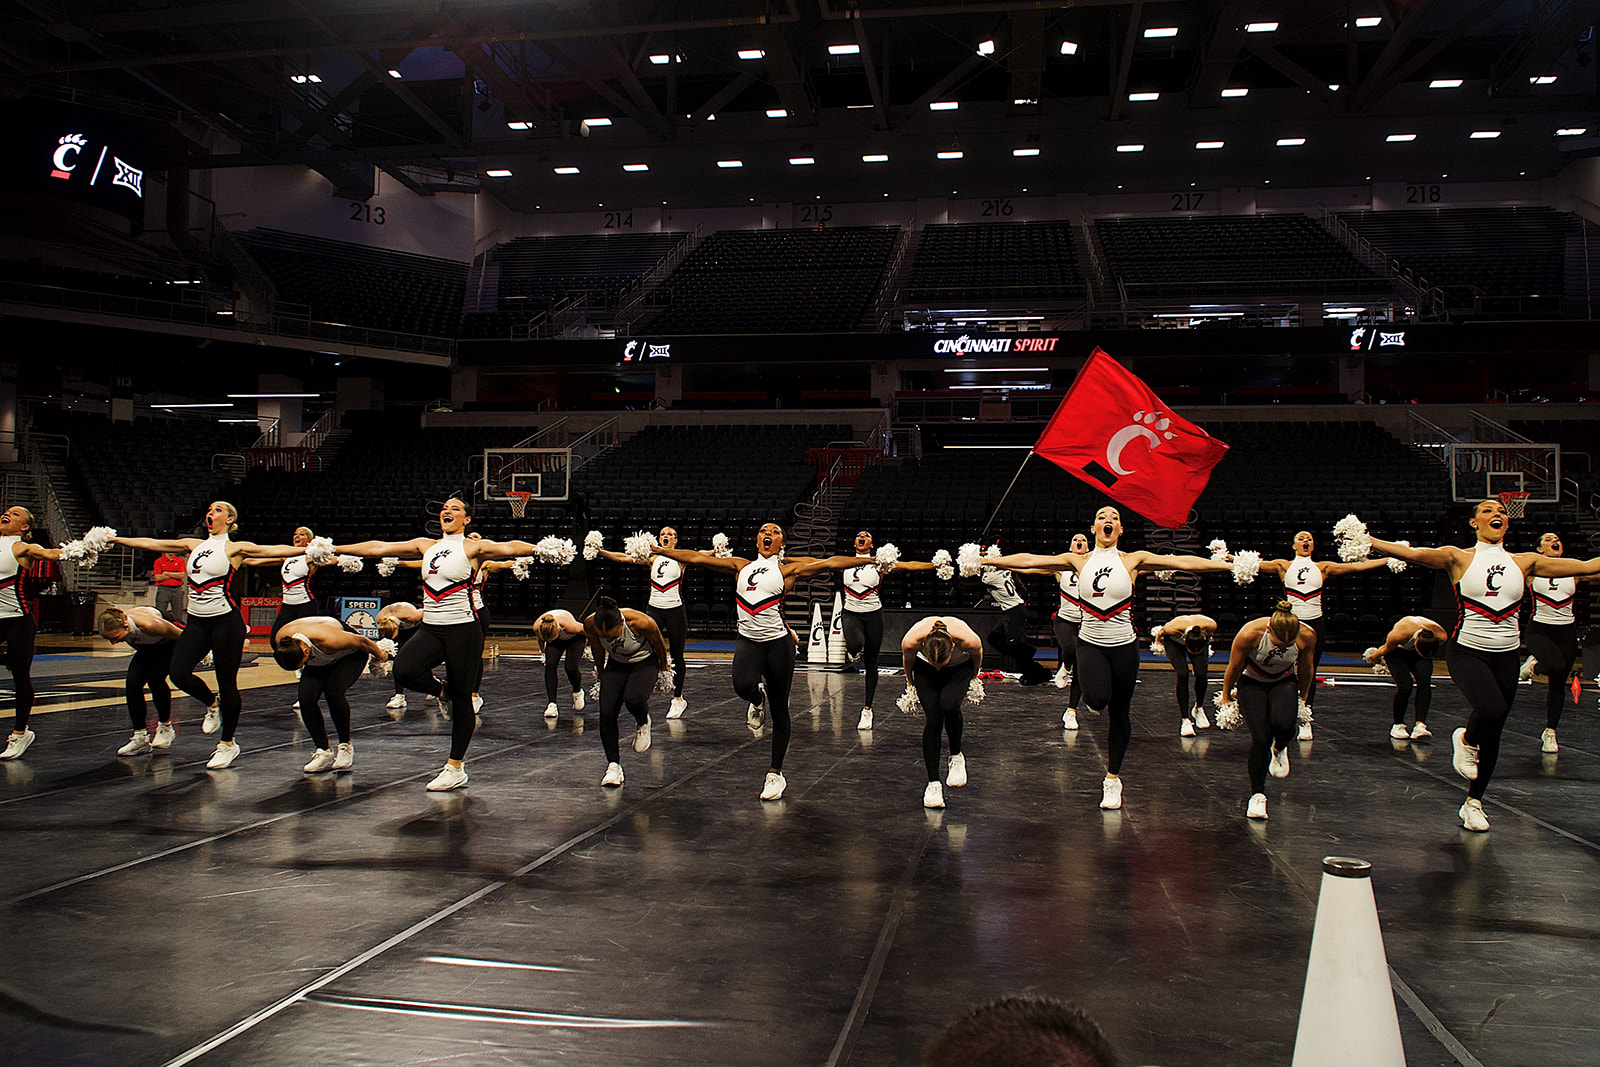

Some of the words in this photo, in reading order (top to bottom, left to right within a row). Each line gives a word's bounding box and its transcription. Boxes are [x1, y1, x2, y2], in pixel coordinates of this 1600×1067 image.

[1172, 193, 1204, 210] 217
[1407, 186, 1440, 203] 218
[350, 202, 385, 225] 213
[801, 206, 832, 222] 215
[982, 200, 1013, 216] 216
[604, 212, 632, 228] 214
[933, 336, 1012, 354] CINCINNATI
[1012, 338, 1060, 352] SPIRIT
